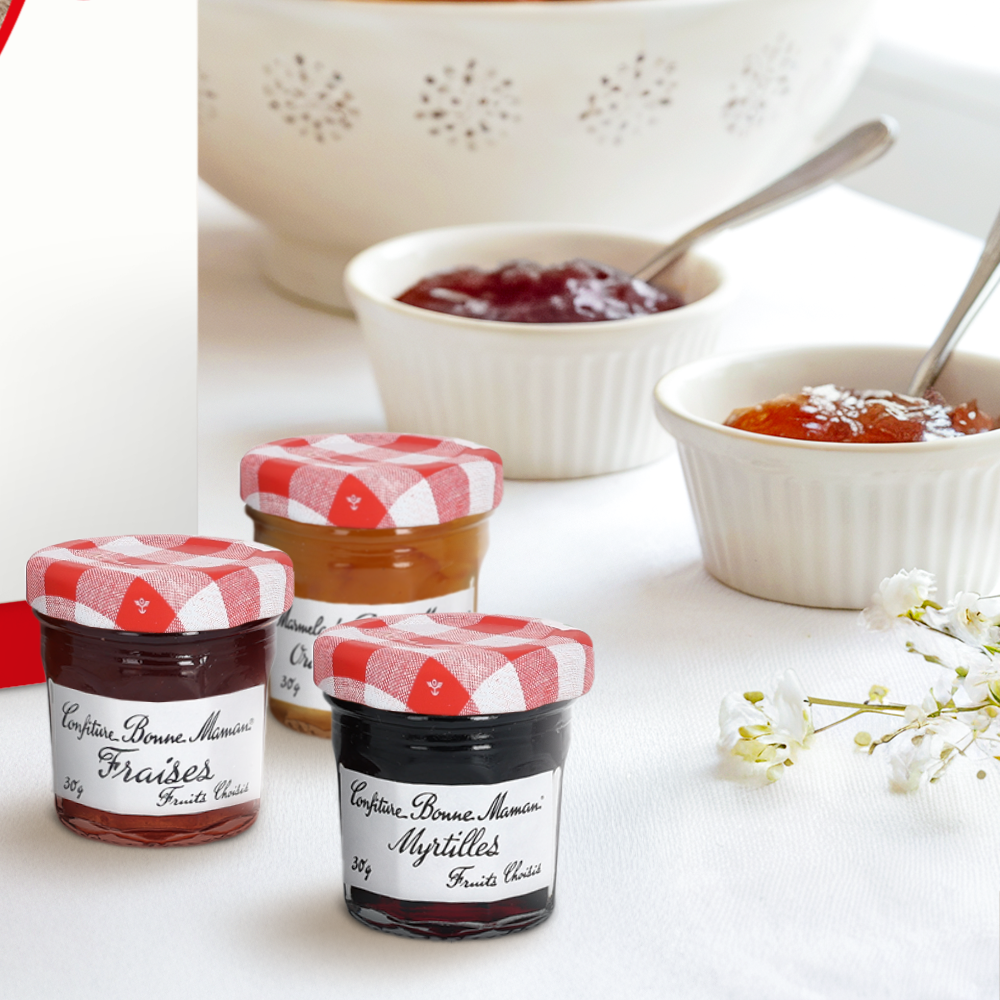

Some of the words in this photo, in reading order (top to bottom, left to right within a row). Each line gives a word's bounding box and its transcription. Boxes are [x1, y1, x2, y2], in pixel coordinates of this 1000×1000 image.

[61, 700, 119, 743] Confiture
[121, 713, 187, 745] Bonne
[97, 746, 216, 785] Fraises
[63, 776, 84, 800] 30g
[156, 784, 207, 808] Fruits
[350, 778, 408, 819] Confiture
[410, 791, 475, 822] Bonne
[387, 826, 500, 868] Myrtilles
[351, 855, 373, 881] 30g
[446, 865, 498, 889] Fruits
